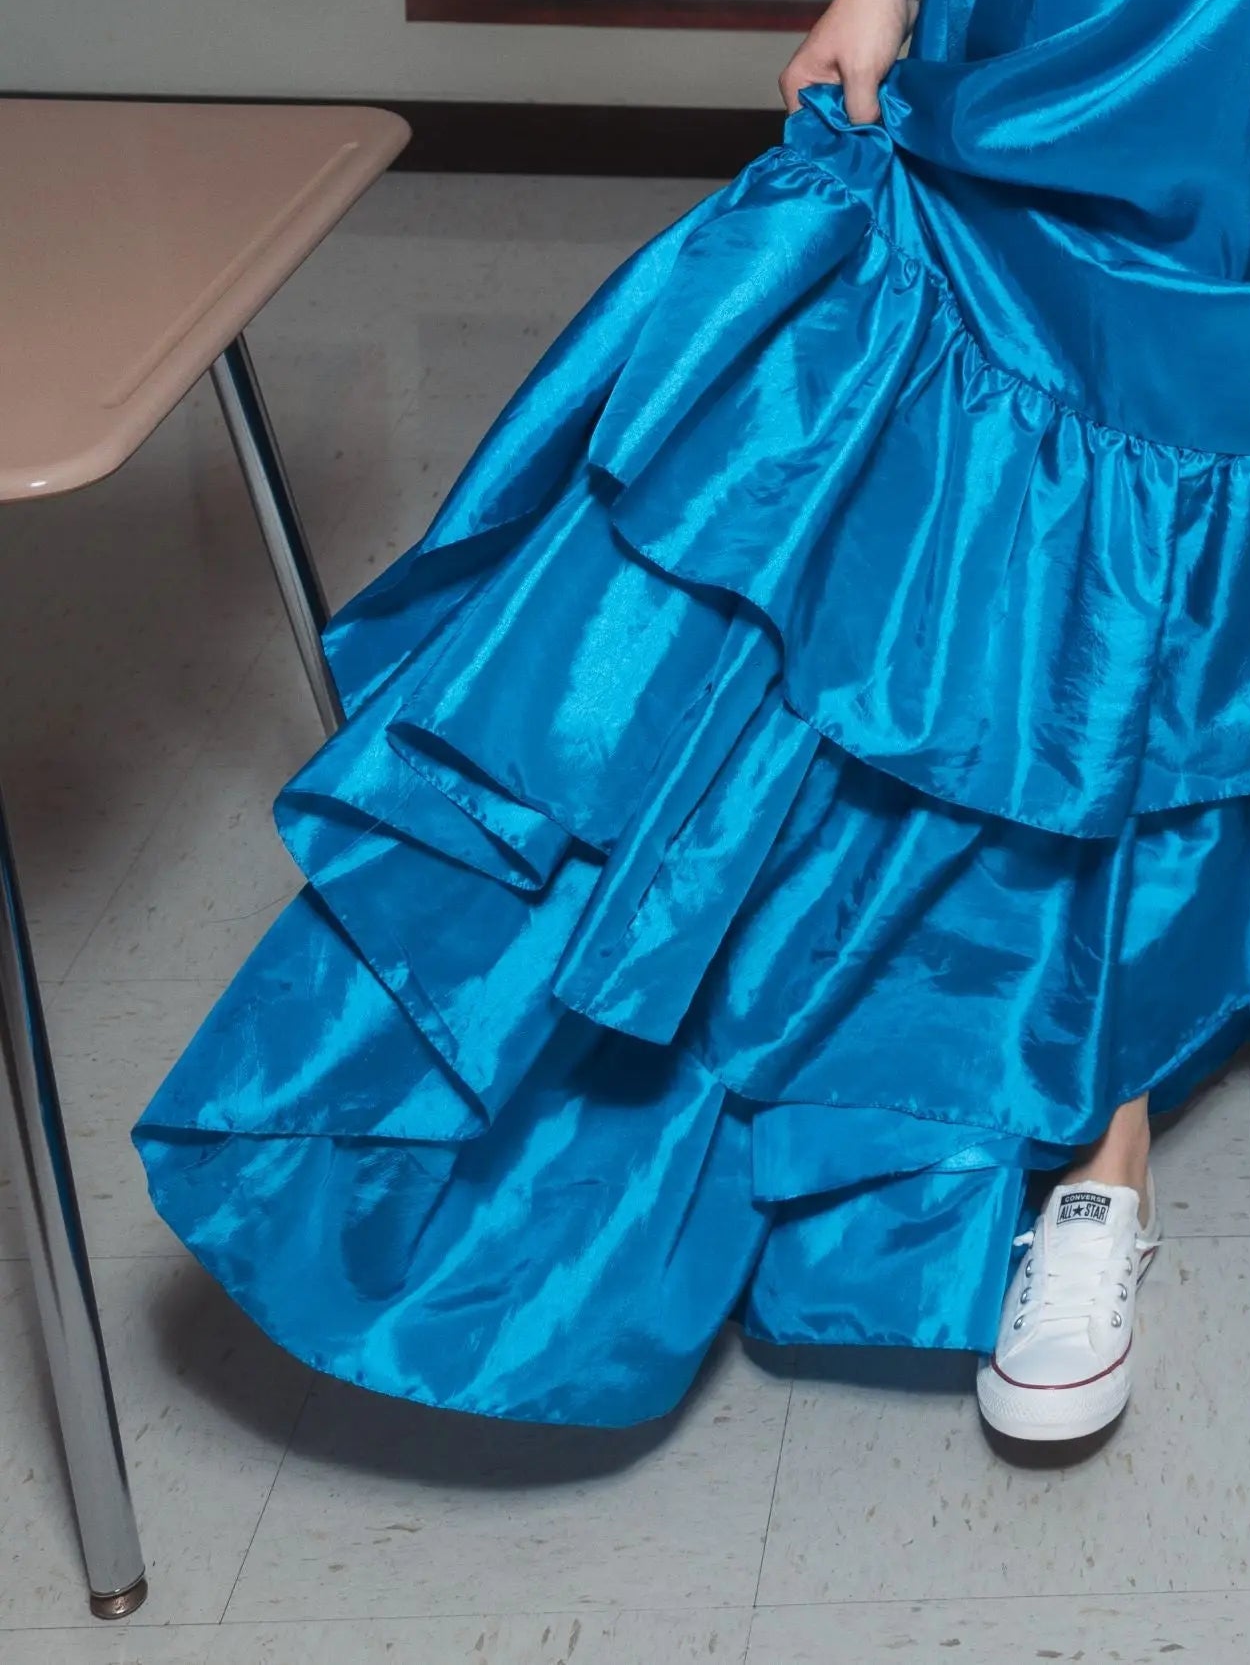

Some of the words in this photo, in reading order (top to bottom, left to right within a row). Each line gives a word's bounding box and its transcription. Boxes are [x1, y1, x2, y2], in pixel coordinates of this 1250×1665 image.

[1064, 1194, 1107, 1204] CONVERSE
[1060, 1204, 1073, 1220] ALL
[1084, 1203, 1106, 1221] STAR
